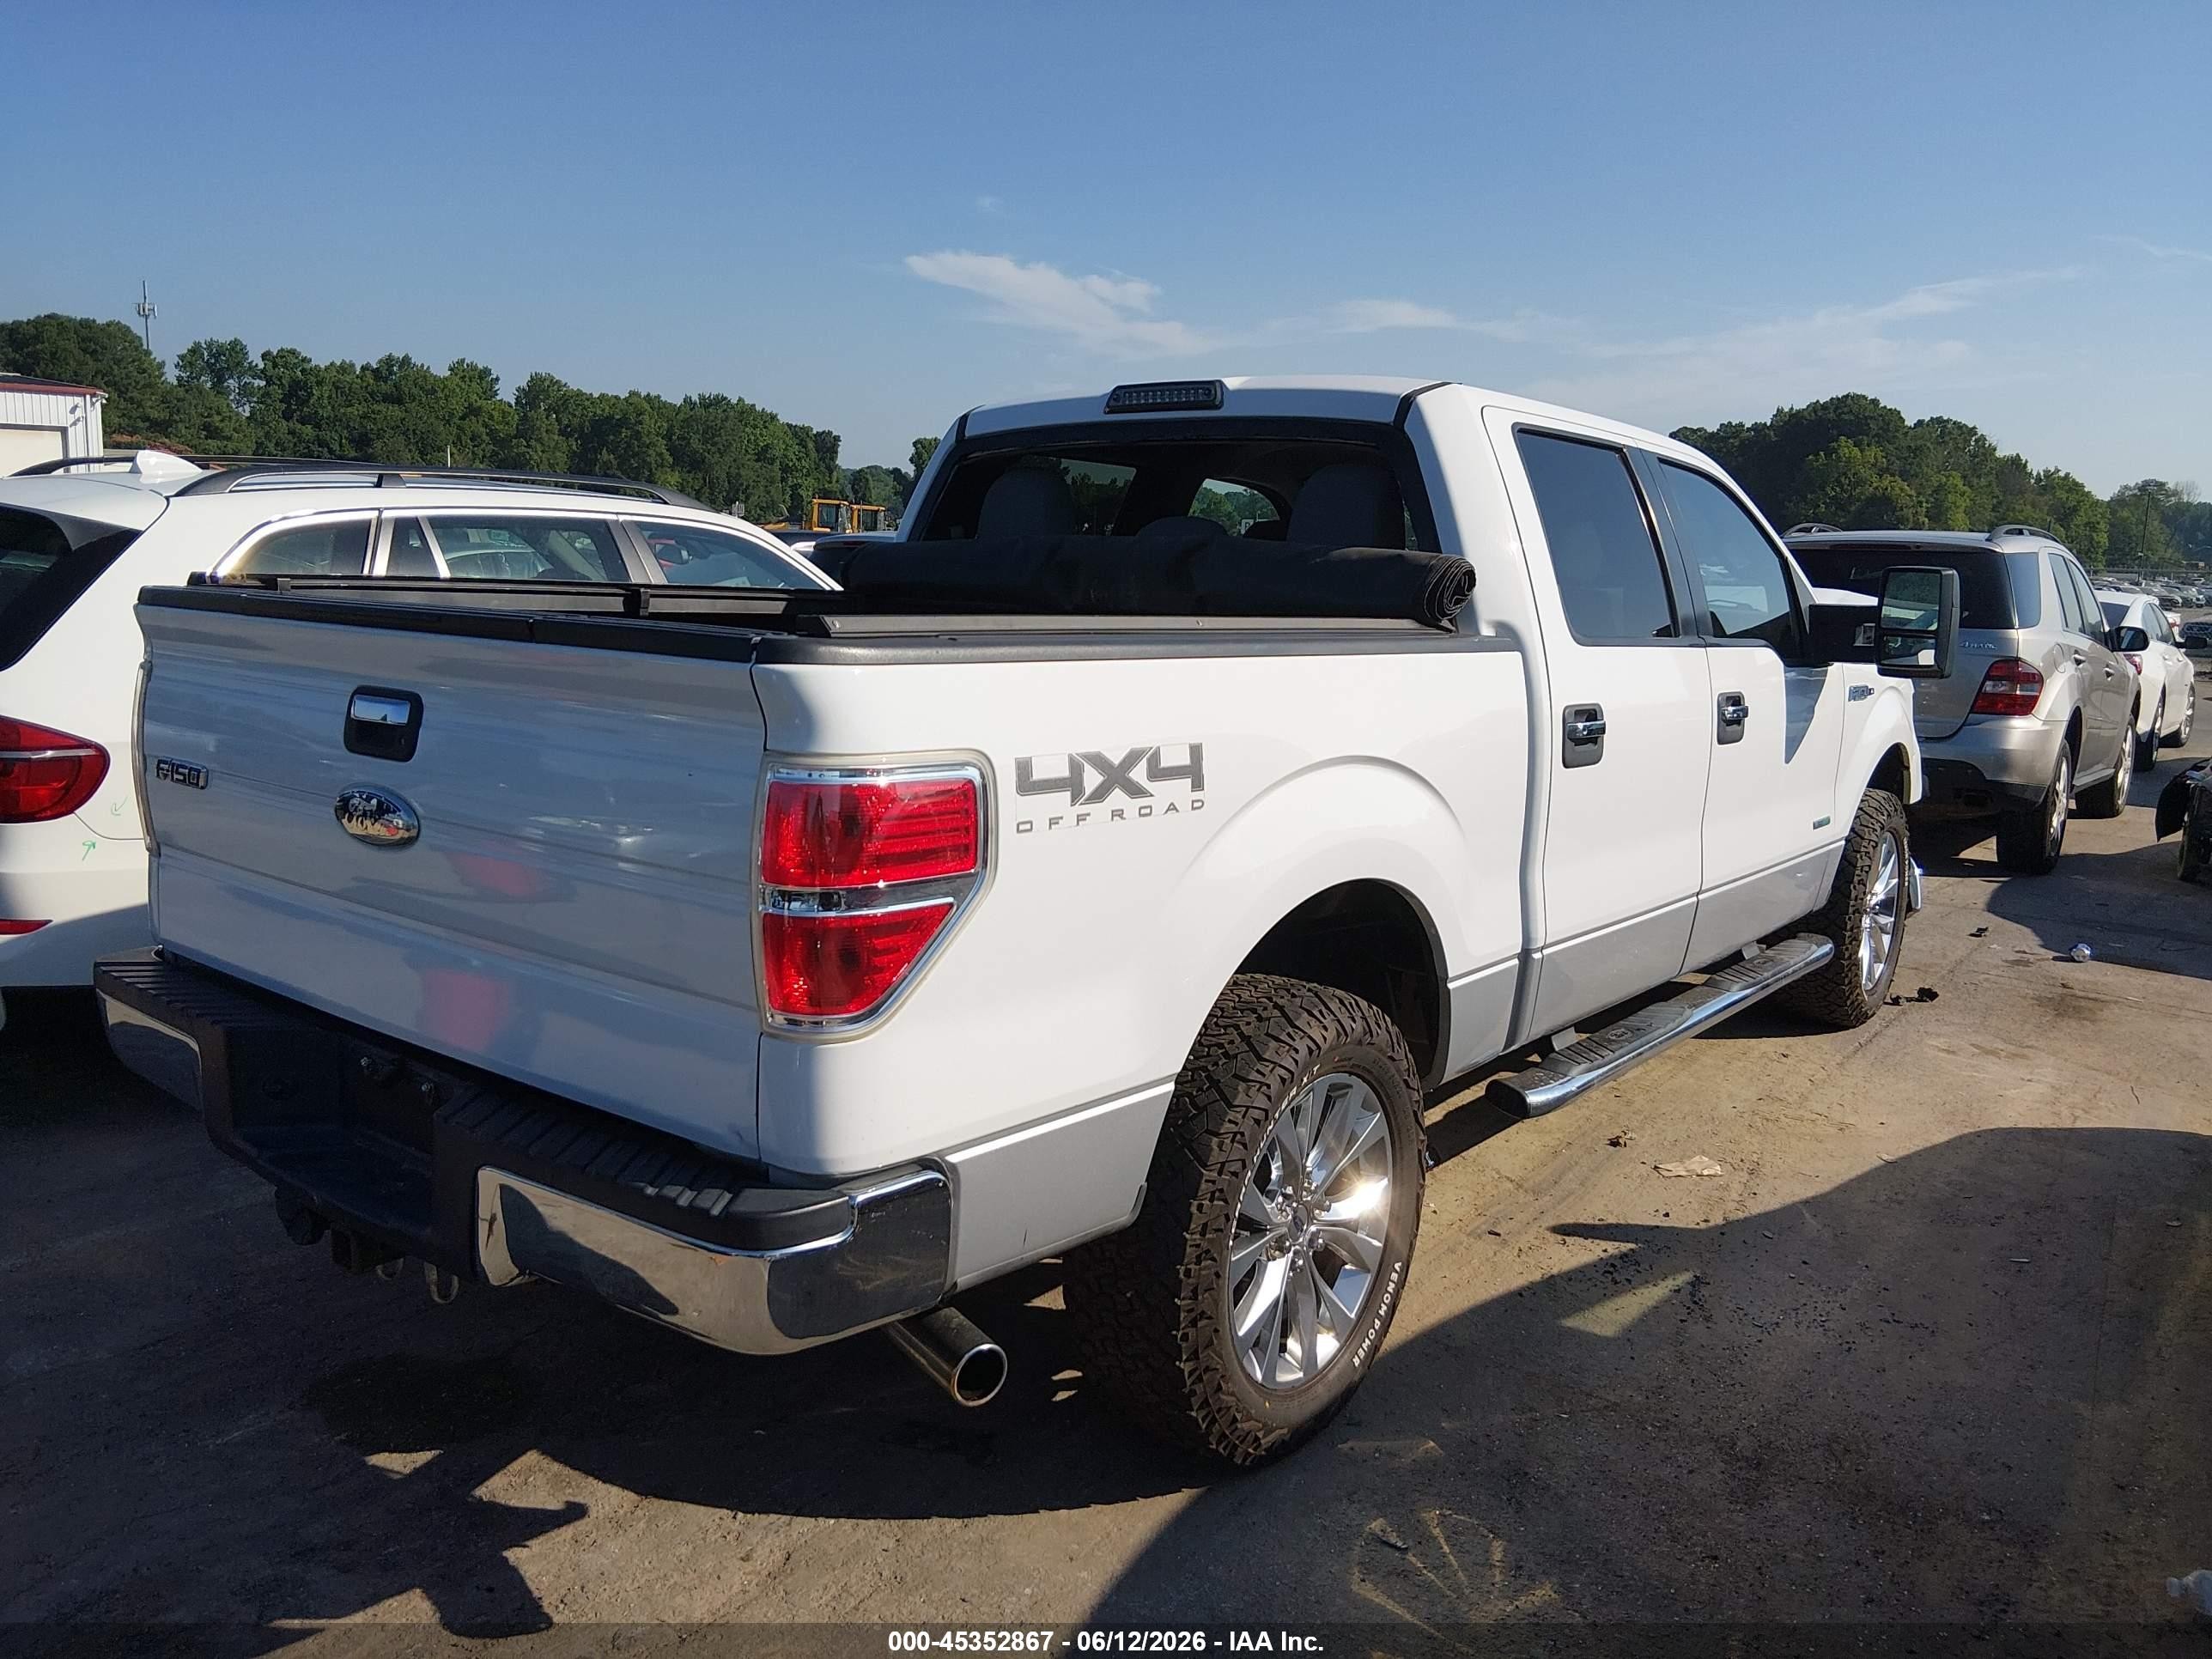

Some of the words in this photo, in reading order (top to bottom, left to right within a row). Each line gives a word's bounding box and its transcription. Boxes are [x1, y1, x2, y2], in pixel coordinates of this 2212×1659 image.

[1017, 813, 1091, 834] OFF
[1111, 799, 1205, 822] ROAD
[1377, 1261, 1402, 1316] VENOM
[1352, 1317, 1381, 1367] POWER
